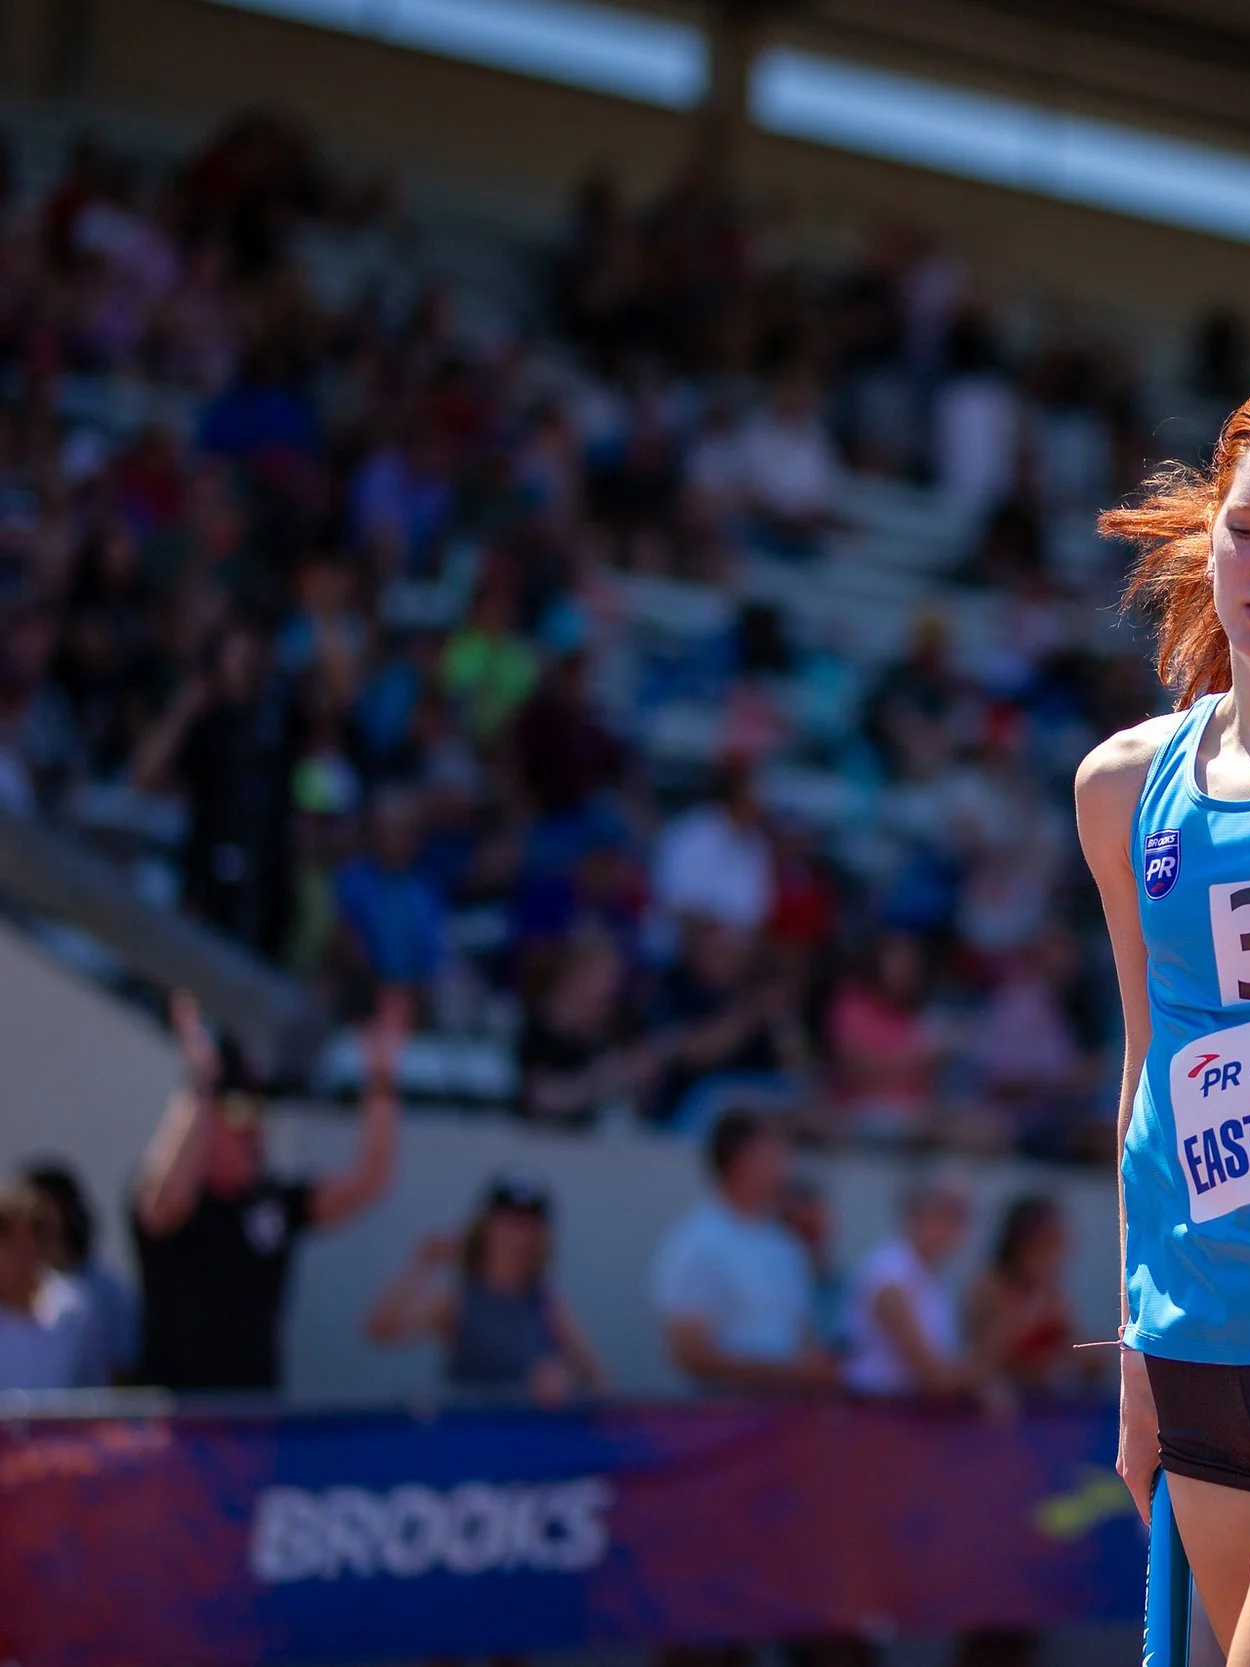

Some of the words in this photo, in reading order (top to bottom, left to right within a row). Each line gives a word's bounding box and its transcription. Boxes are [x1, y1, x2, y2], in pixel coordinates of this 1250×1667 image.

[1147, 833, 1176, 848] BROOKS
[1146, 856, 1176, 882] PR
[1199, 1061, 1242, 1098] PR
[255, 1479, 611, 1580] BROOKS
